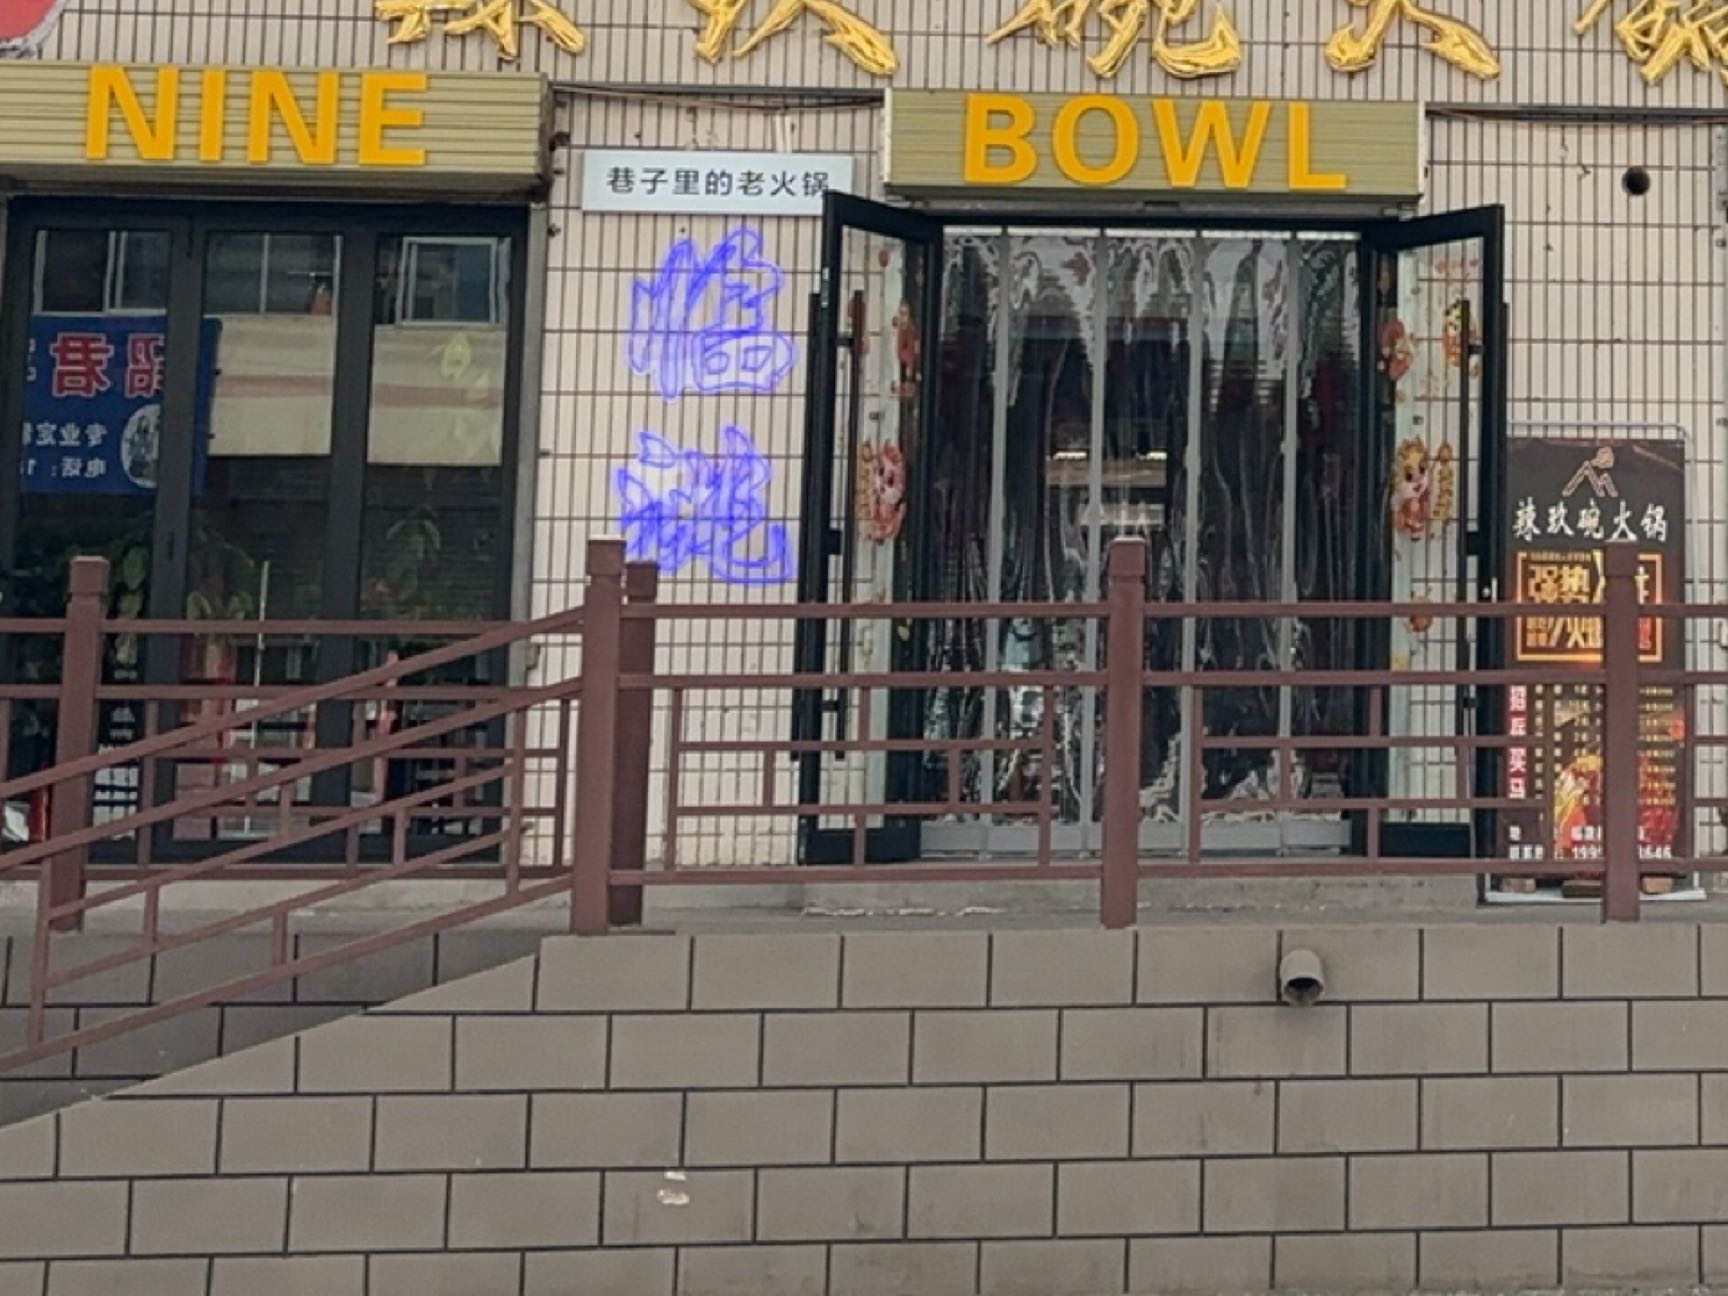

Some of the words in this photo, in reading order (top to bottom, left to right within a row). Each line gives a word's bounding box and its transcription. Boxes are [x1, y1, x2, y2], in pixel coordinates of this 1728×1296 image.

[86, 64, 428, 166] NINE
[964, 92, 1348, 191] BOWL
[607, 167, 829, 197] 巷子里的老火锅
[1512, 496, 1669, 543] 辣玖碗火锅
